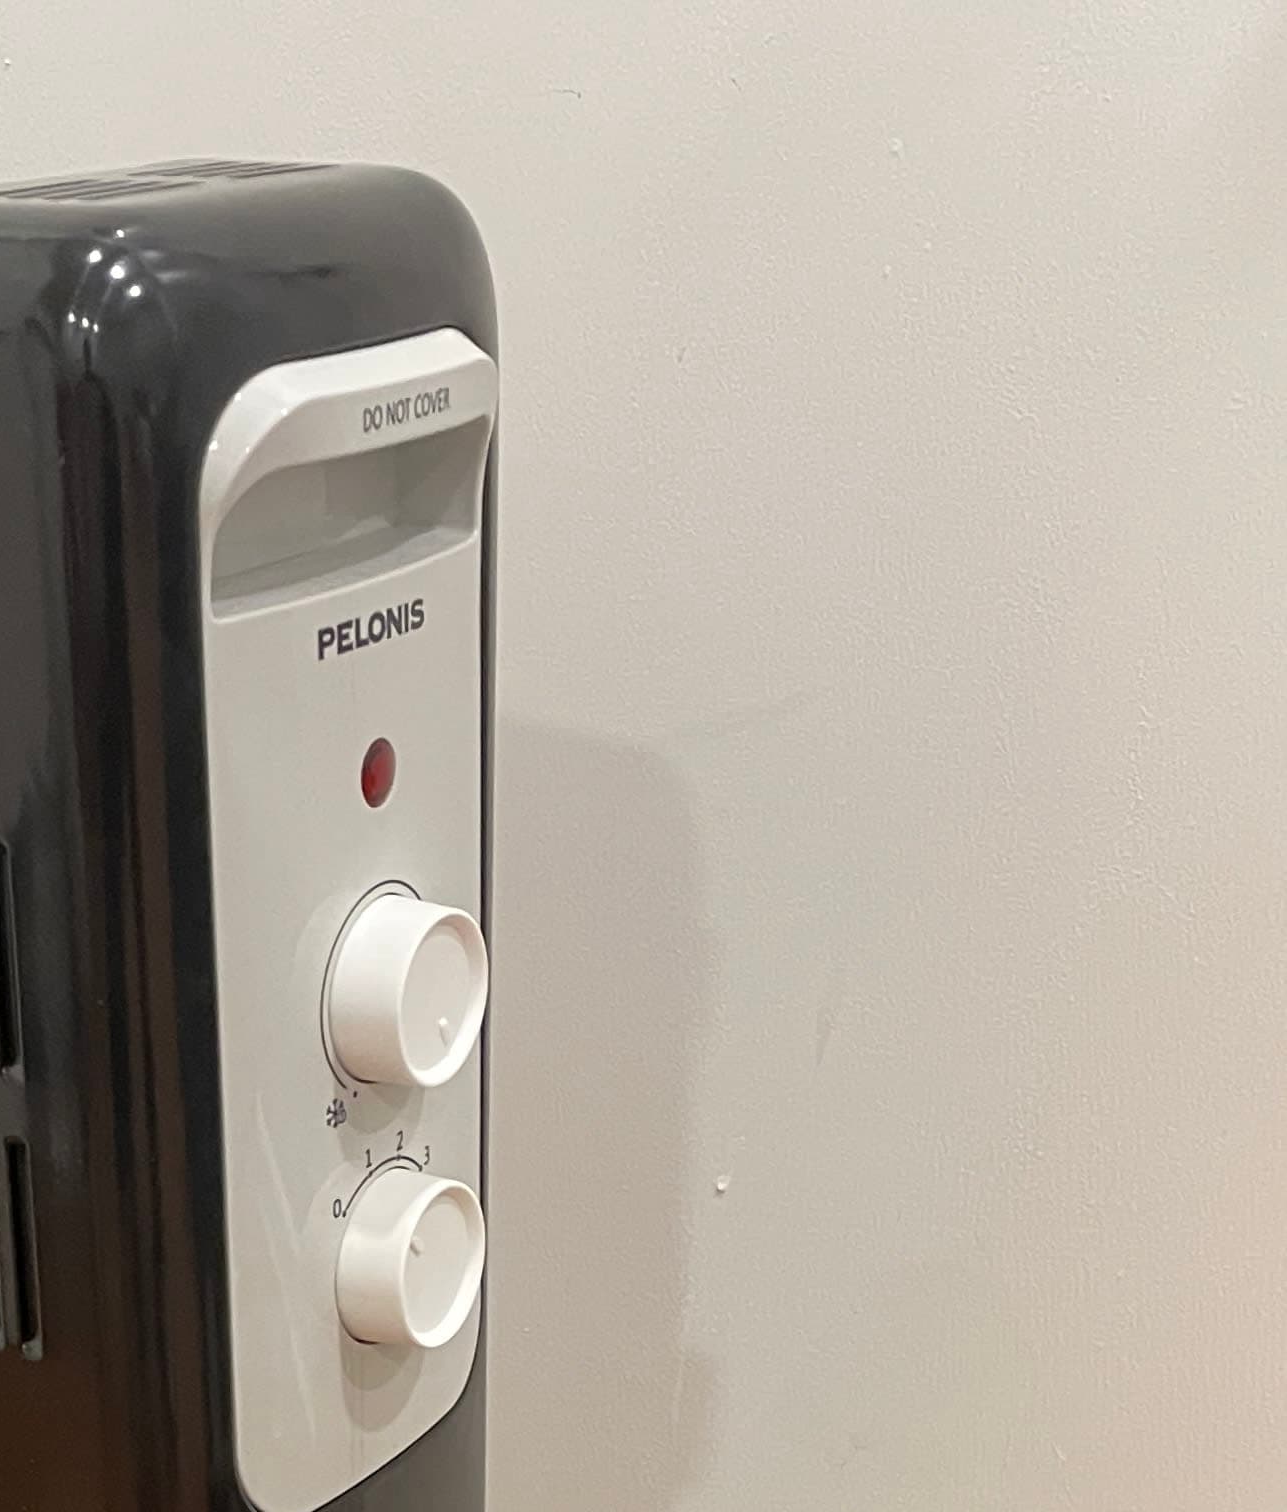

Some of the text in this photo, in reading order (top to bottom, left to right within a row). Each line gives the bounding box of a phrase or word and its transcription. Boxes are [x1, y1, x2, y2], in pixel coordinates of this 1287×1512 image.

[362, 386, 451, 433] DO NOT COVER
[317, 598, 425, 662] PELONIS
[333, 1130, 430, 1218] 0 1 2 3
